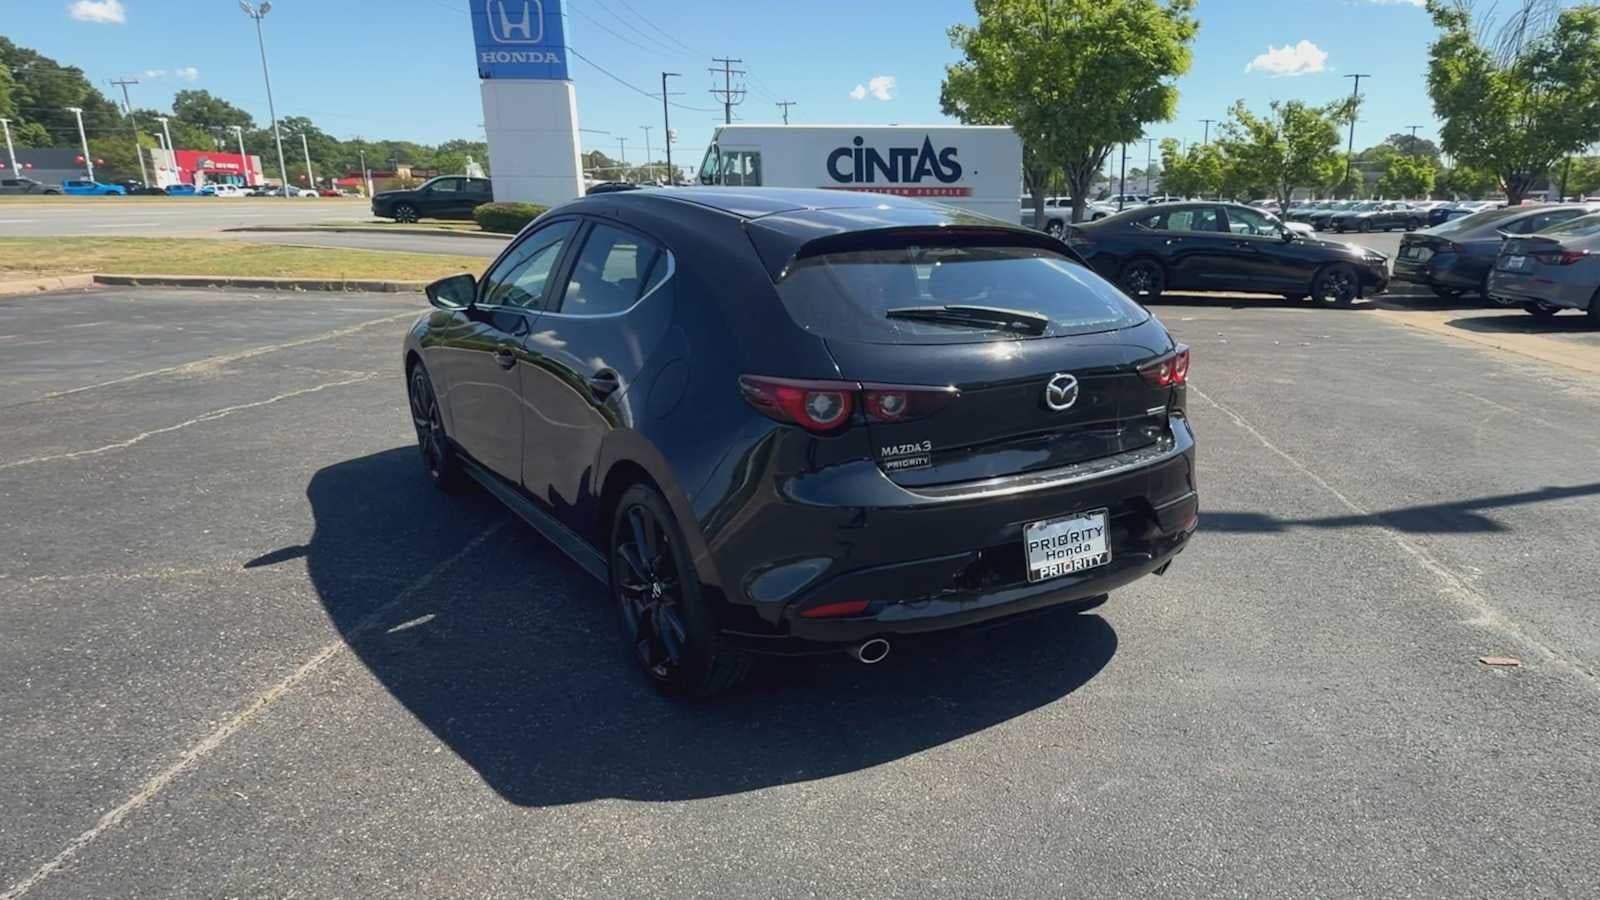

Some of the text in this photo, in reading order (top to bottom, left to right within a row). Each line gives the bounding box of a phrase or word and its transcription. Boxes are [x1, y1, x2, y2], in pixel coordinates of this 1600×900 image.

[480, 51, 560, 64] HONDA
[881, 440, 932, 457] MAZDA3
[886, 457, 928, 469] PRIORITY
[1029, 526, 1103, 553] PRIORITY
[1046, 543, 1091, 561] Honda
[1040, 553, 1104, 579] PRIORITY
